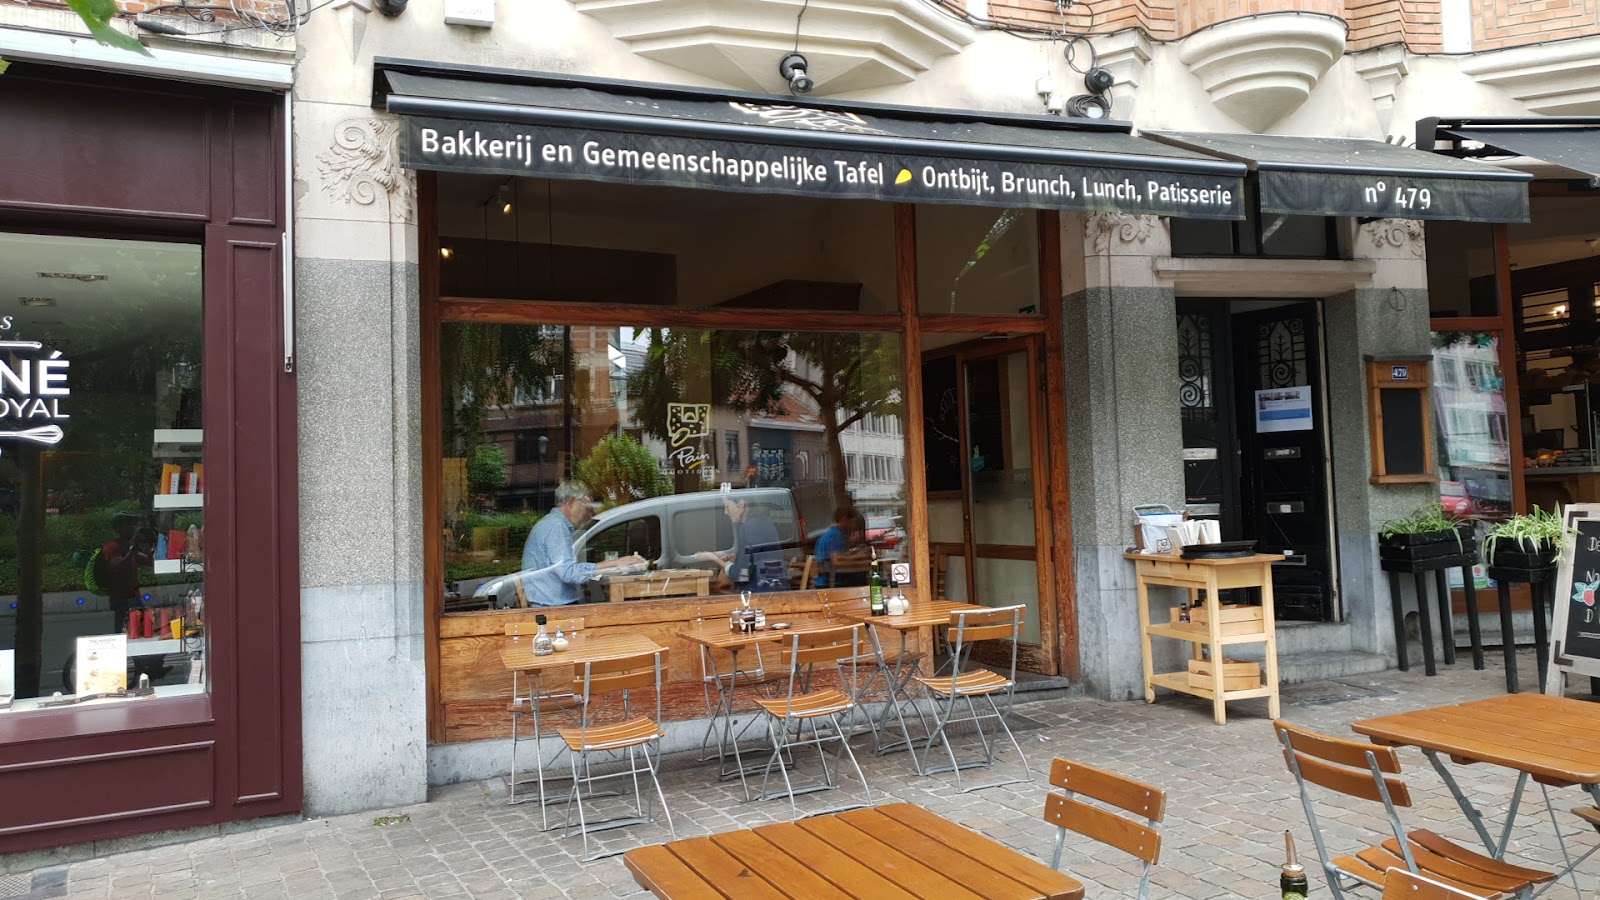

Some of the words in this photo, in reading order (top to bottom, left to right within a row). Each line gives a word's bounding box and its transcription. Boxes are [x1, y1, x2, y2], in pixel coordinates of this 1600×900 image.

[421, 128, 532, 167] Bakkerij
[541, 143, 573, 164] en
[583, 140, 828, 186] Gemeenschappelijke
[833, 159, 884, 186] Tafel
[921, 165, 996, 196] Ontbijt,
[1001, 171, 1076, 200] Brunch,
[1082, 176, 1142, 204] Lunch,
[1147, 180, 1232, 206] Patisserie
[1394, 186, 1431, 210] 479
[669, 446, 710, 468] Pain
